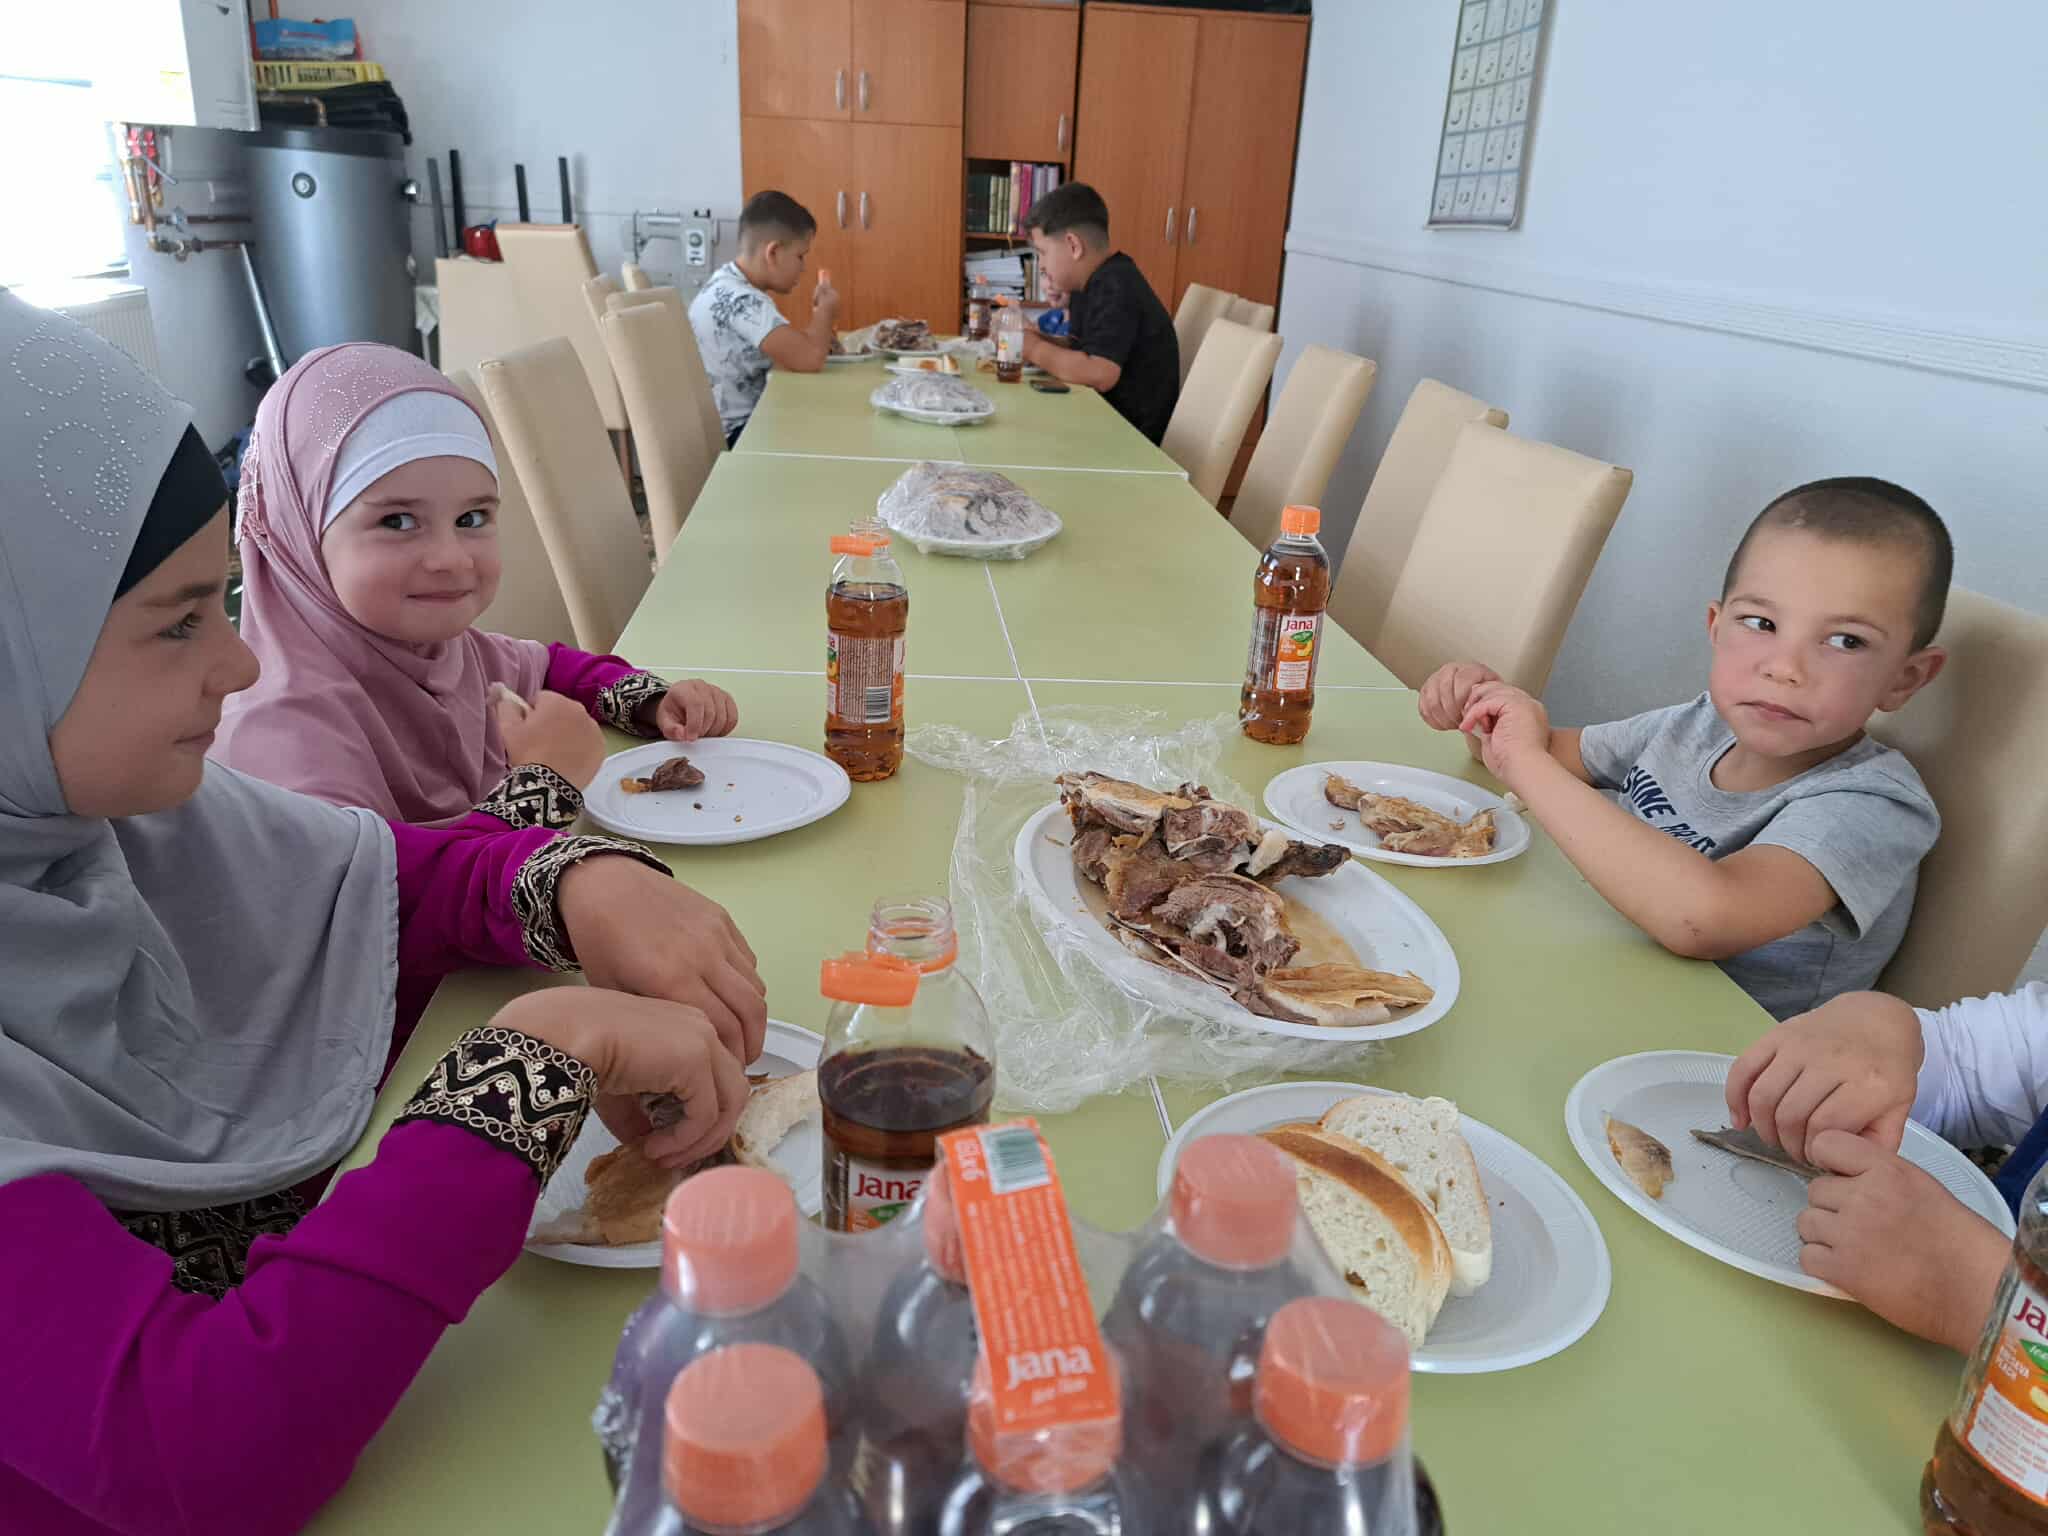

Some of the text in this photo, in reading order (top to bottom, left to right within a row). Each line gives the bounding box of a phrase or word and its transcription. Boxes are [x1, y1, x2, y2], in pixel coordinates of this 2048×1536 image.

[1282, 619, 1313, 632] Jana
[853, 1173, 923, 1201] Jana
[2013, 1296, 2048, 1340] Ja
[1005, 1343, 1095, 1391] Jana
